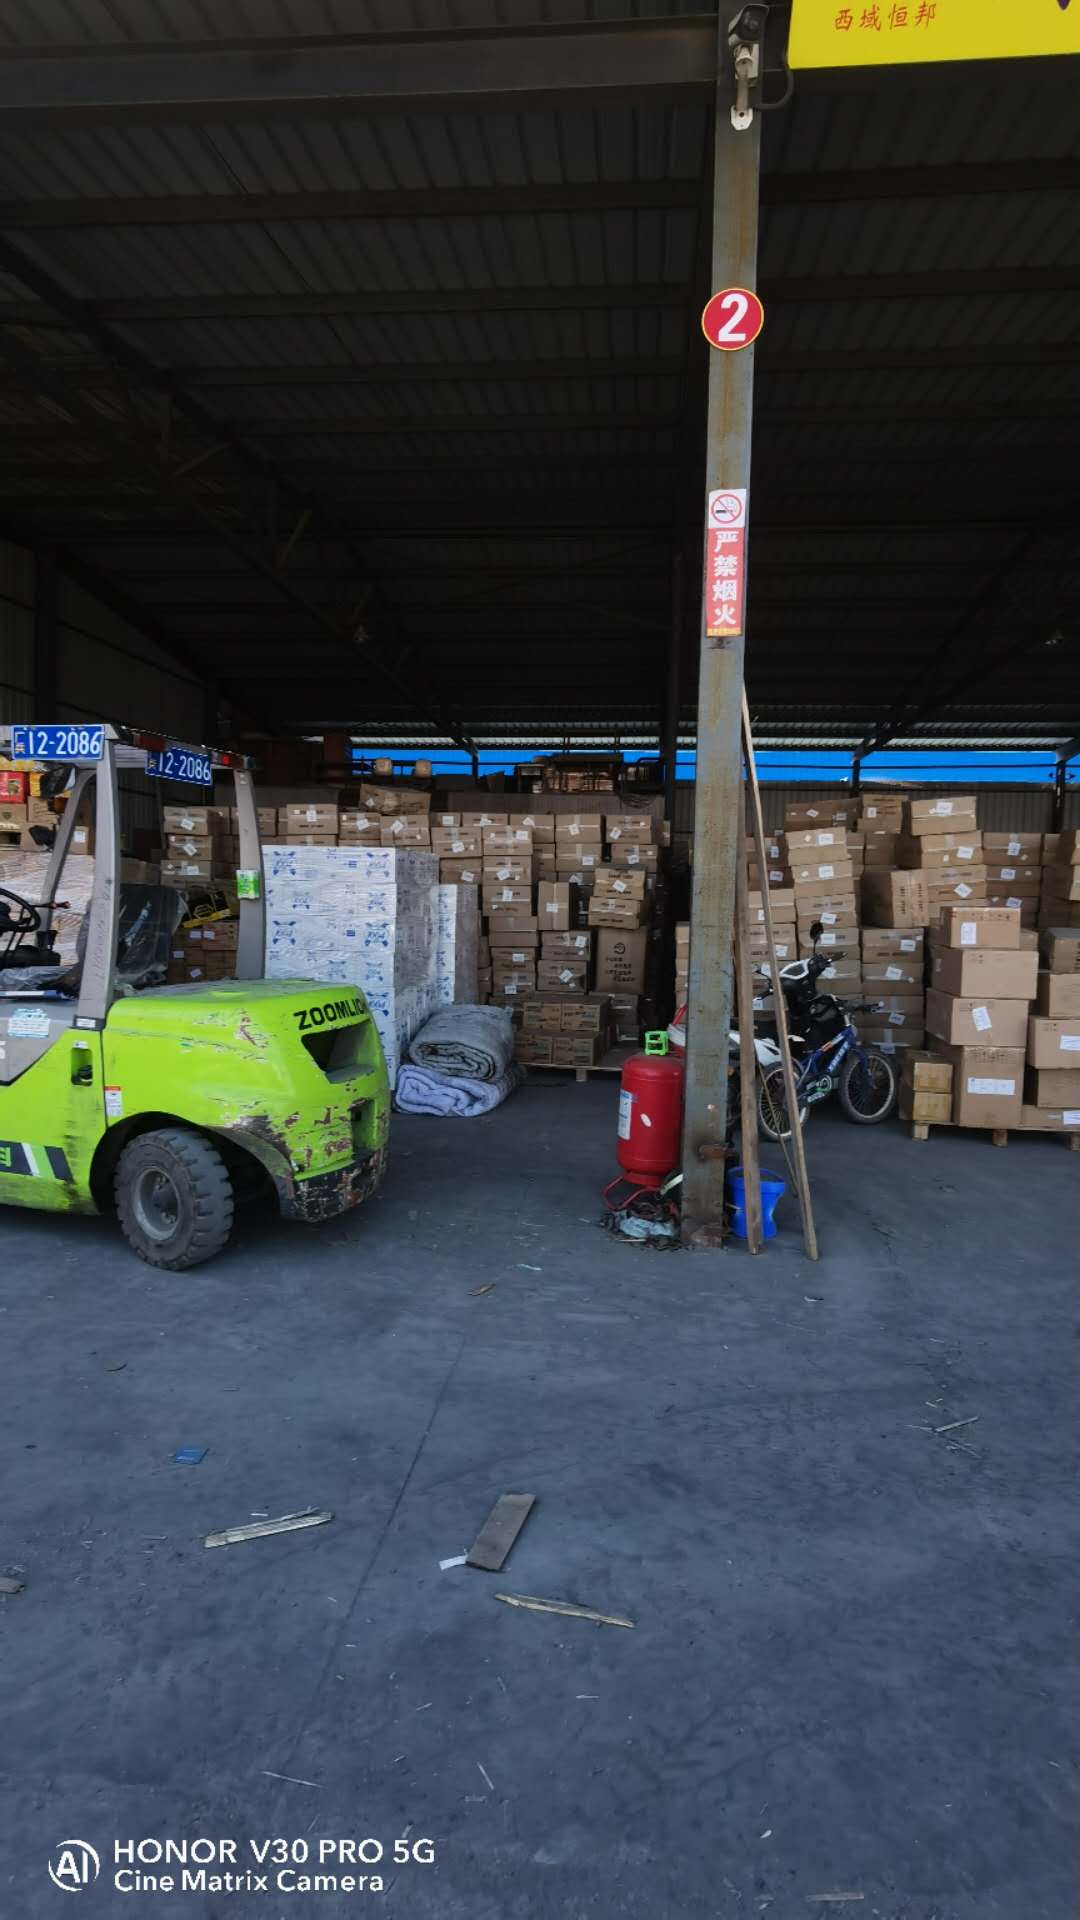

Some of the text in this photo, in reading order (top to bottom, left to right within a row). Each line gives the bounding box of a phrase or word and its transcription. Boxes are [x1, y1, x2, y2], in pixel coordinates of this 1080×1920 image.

[834, 1, 937, 32] 西域恒邦
[718, 293, 749, 342] 2
[713, 530, 739, 626] 严禁烟火
